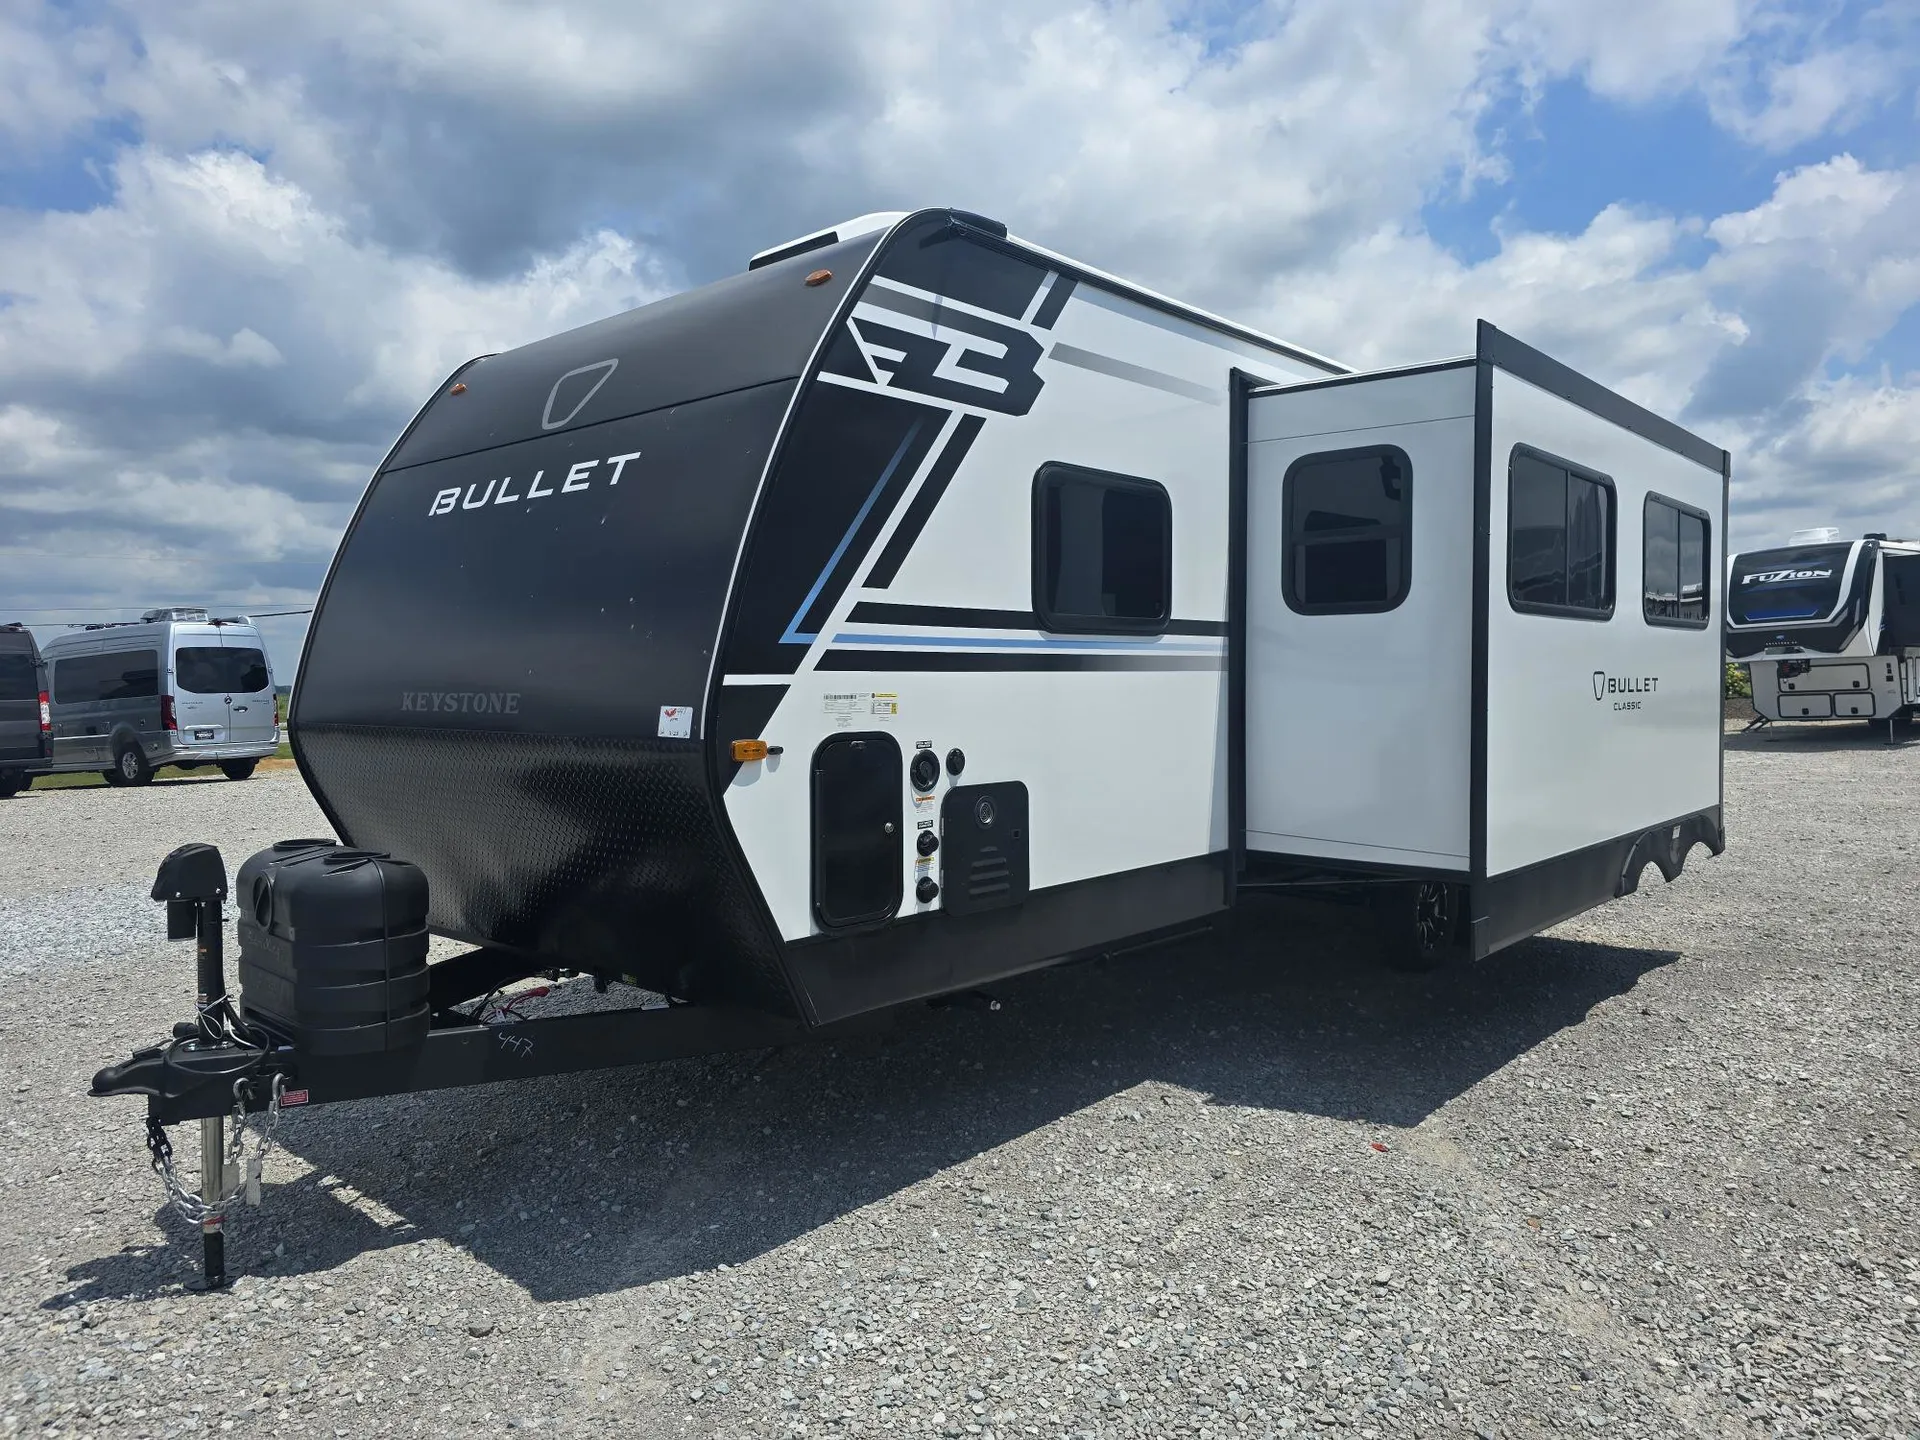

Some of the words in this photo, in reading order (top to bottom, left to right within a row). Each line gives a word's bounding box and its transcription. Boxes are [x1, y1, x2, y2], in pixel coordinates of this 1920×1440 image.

[428, 451, 642, 517] BULLET
[1741, 569, 1833, 585] FUZION
[1607, 677, 1659, 693] BULLET
[399, 692, 522, 715] KEYSTONE
[1613, 701, 1642, 711] CLASSIC
